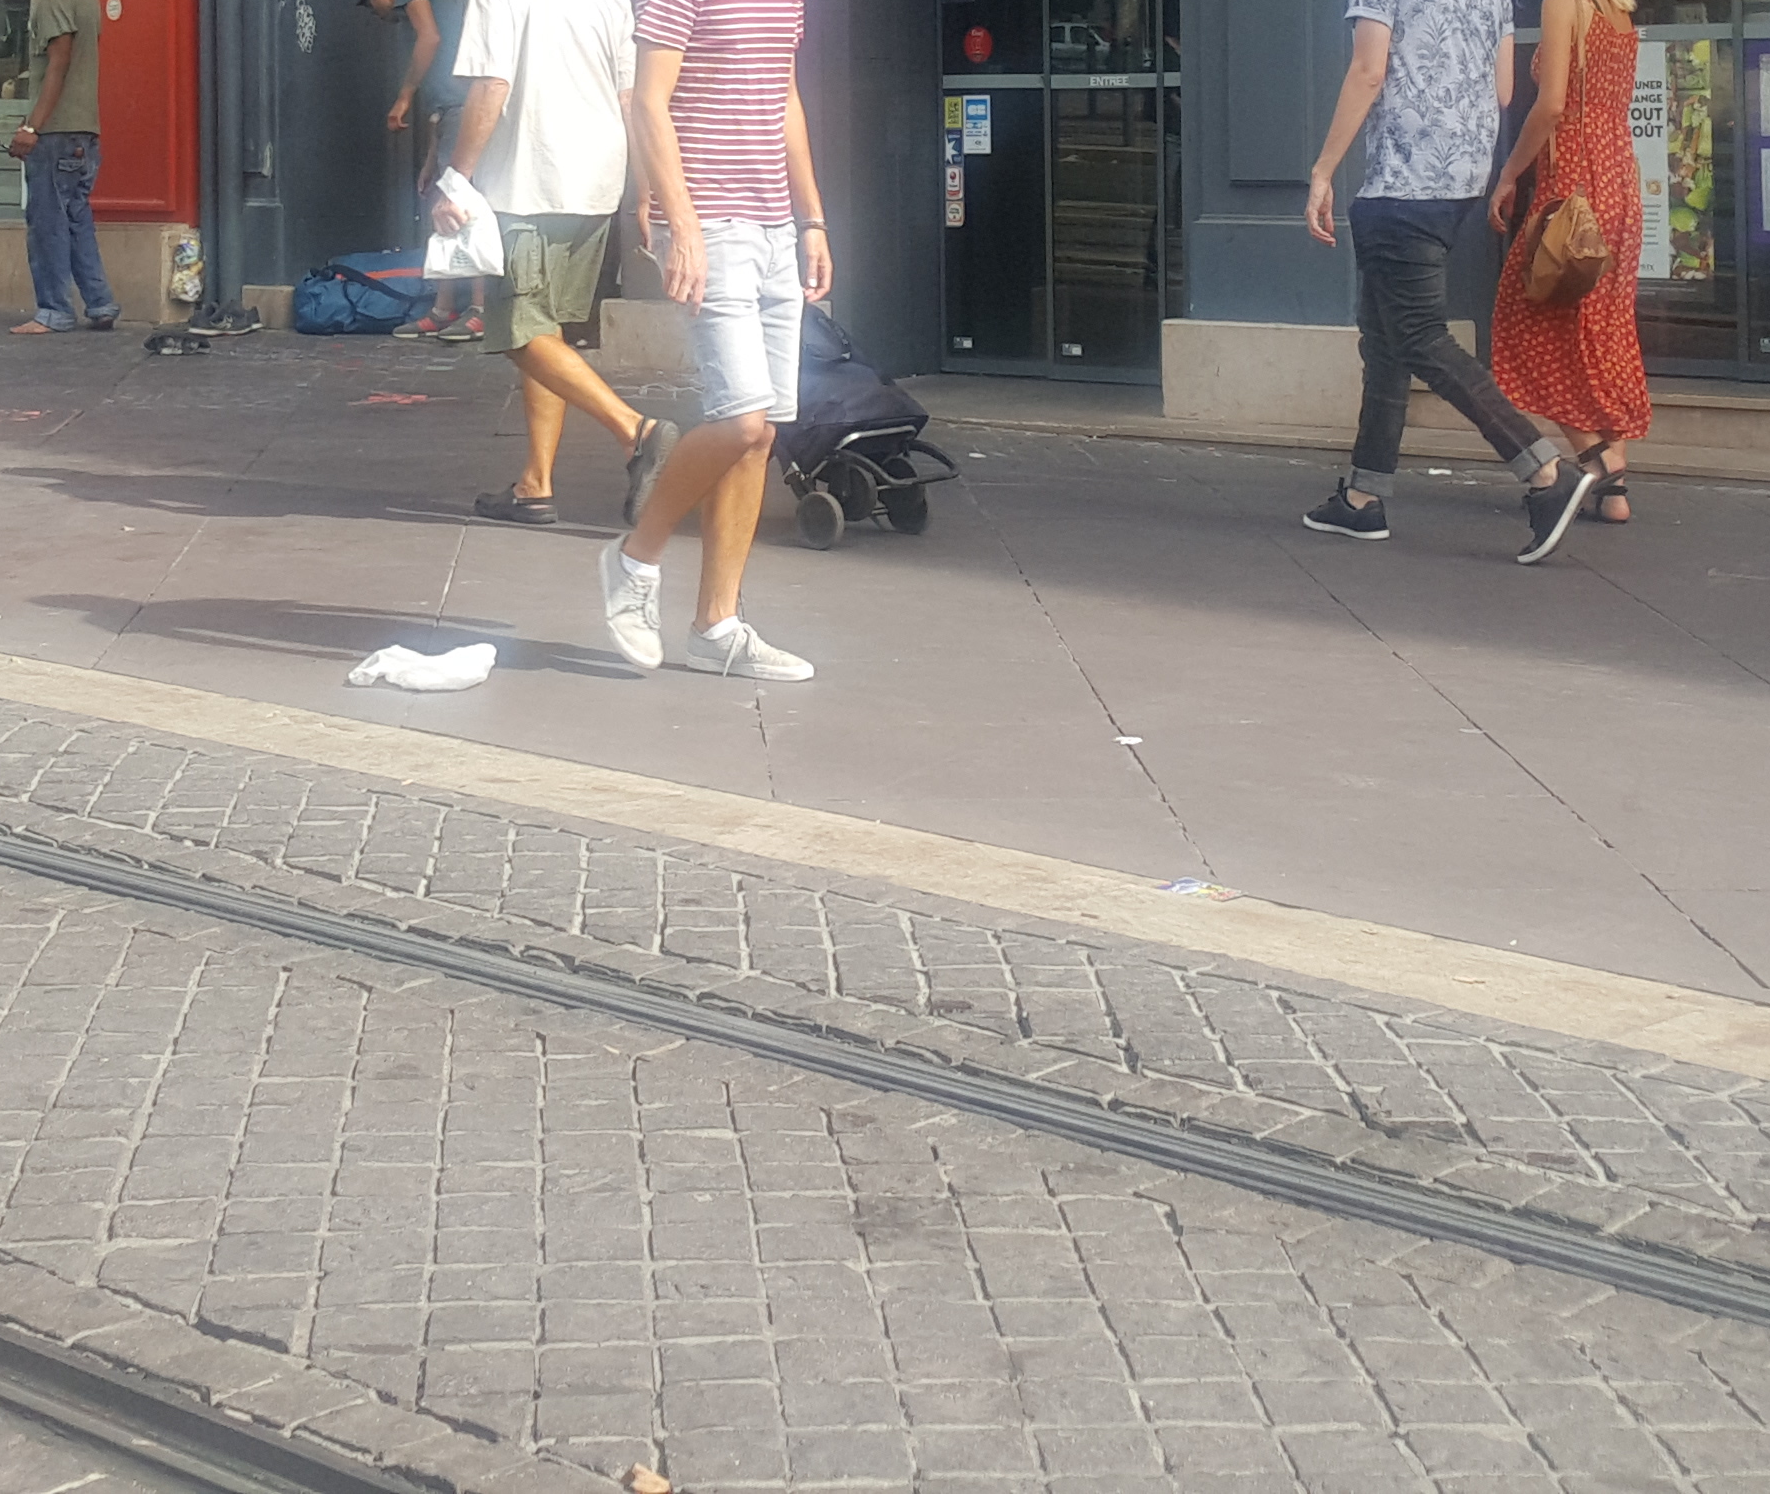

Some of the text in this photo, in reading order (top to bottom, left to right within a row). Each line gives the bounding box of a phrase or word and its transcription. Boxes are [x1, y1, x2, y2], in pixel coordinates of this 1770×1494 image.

[1090, 76, 1130, 86] ENTREE
[1632, 94, 1664, 103] ANGE
[1628, 107, 1663, 121] OUT
